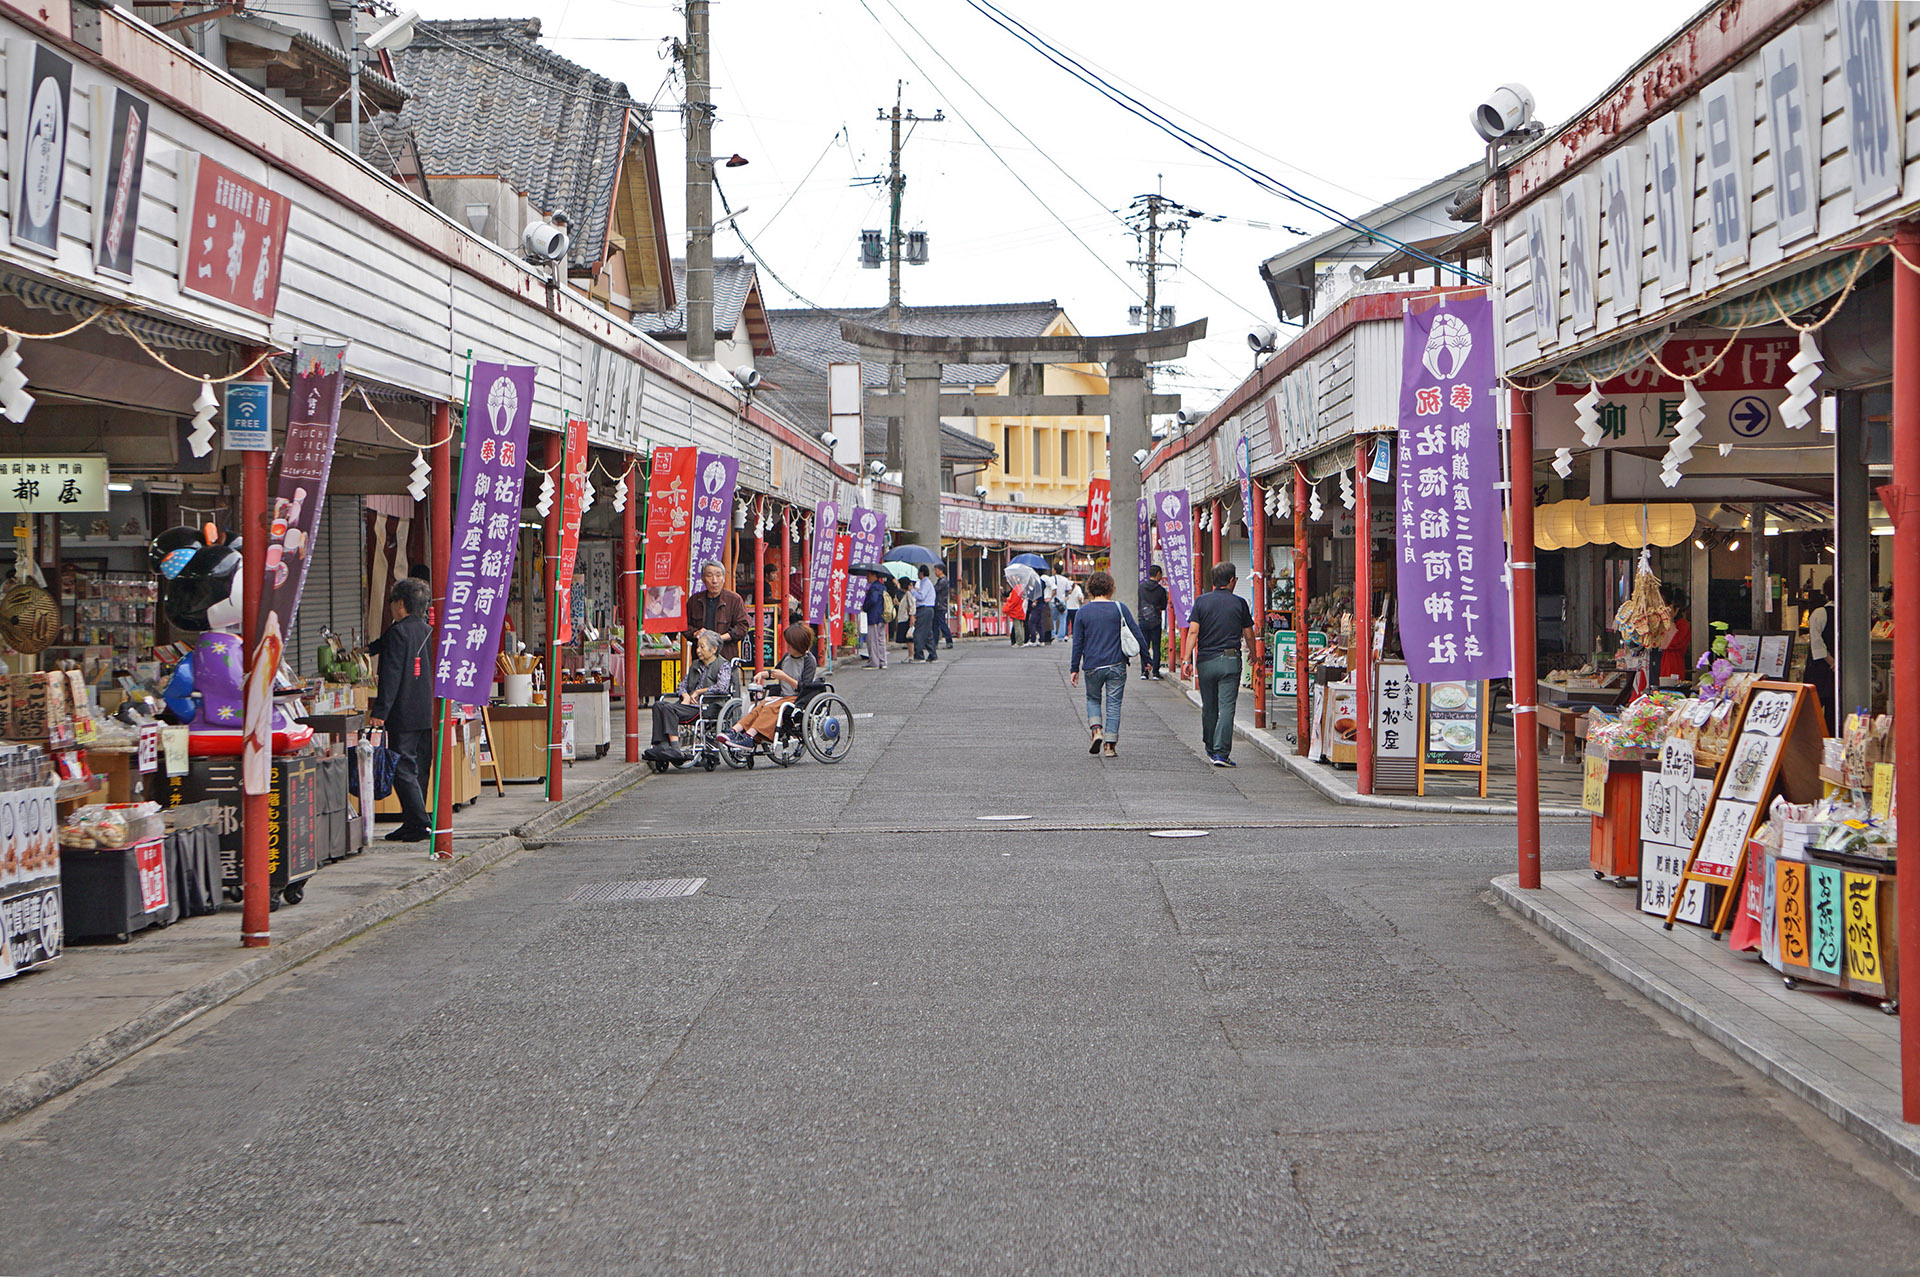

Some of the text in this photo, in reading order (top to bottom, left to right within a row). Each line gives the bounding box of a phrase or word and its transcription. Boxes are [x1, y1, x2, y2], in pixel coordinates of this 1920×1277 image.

[1572, 340, 1790, 389] みやげ
[234, 418, 261, 428] FREE
[437, 472, 491, 685] 御鎮座三百三十年
[455, 474, 514, 688] 祐徳稲荷神社
[1382, 679, 1401, 750] 若松屋
[1782, 865, 1804, 959] あめがた
